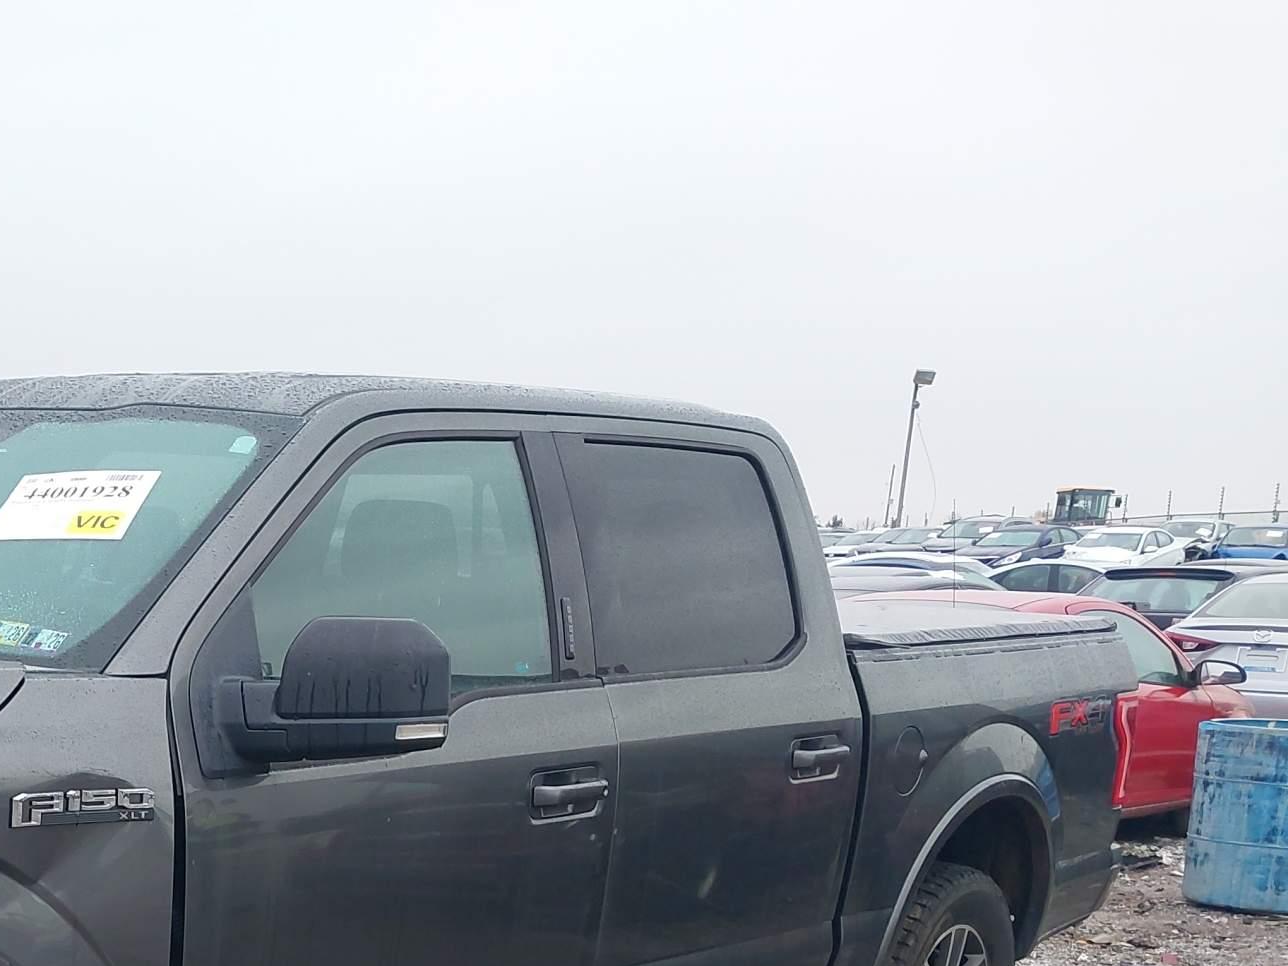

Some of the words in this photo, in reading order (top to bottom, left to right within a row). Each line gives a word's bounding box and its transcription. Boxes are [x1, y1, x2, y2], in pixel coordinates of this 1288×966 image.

[24, 485, 134, 499] 44001928
[76, 515, 119, 529] VIC
[119, 810, 149, 820] XLT
